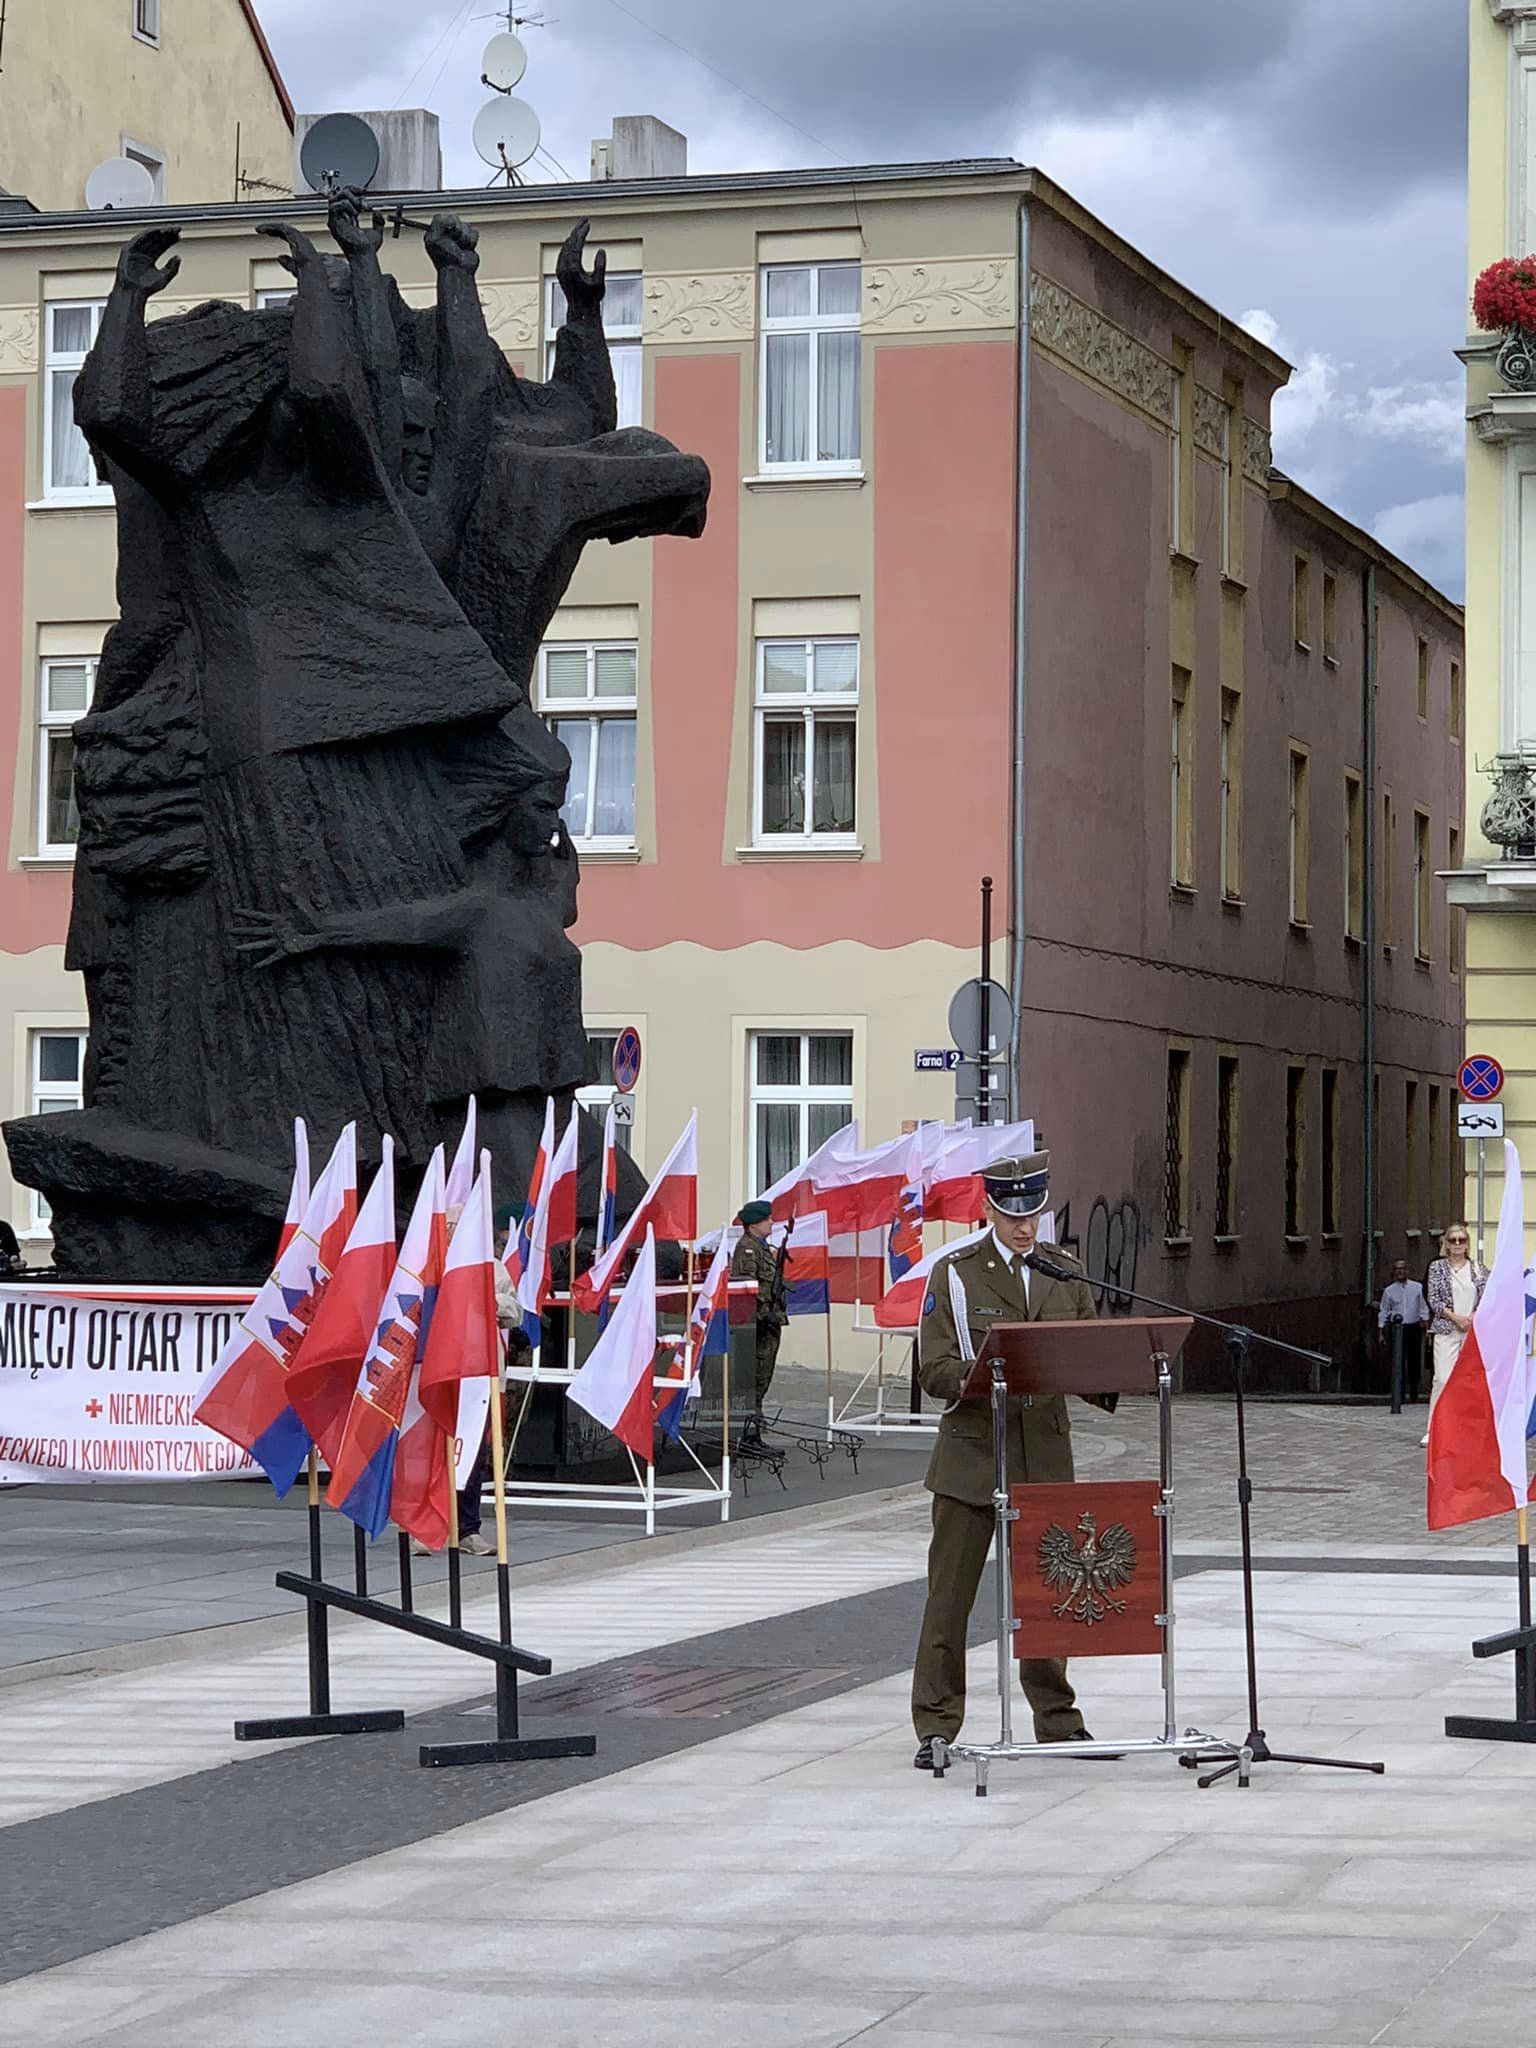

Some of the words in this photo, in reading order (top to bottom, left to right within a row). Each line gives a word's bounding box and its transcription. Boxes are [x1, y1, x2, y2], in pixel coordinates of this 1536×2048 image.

[917, 1053, 943, 1067] Farna
[950, 1052, 960, 1069] 2
[87, 1309, 182, 1372] OFIAR
[72, 1440, 77, 1471] I
[81, 1439, 236, 1473] KOMUNISTYCZNEGO
